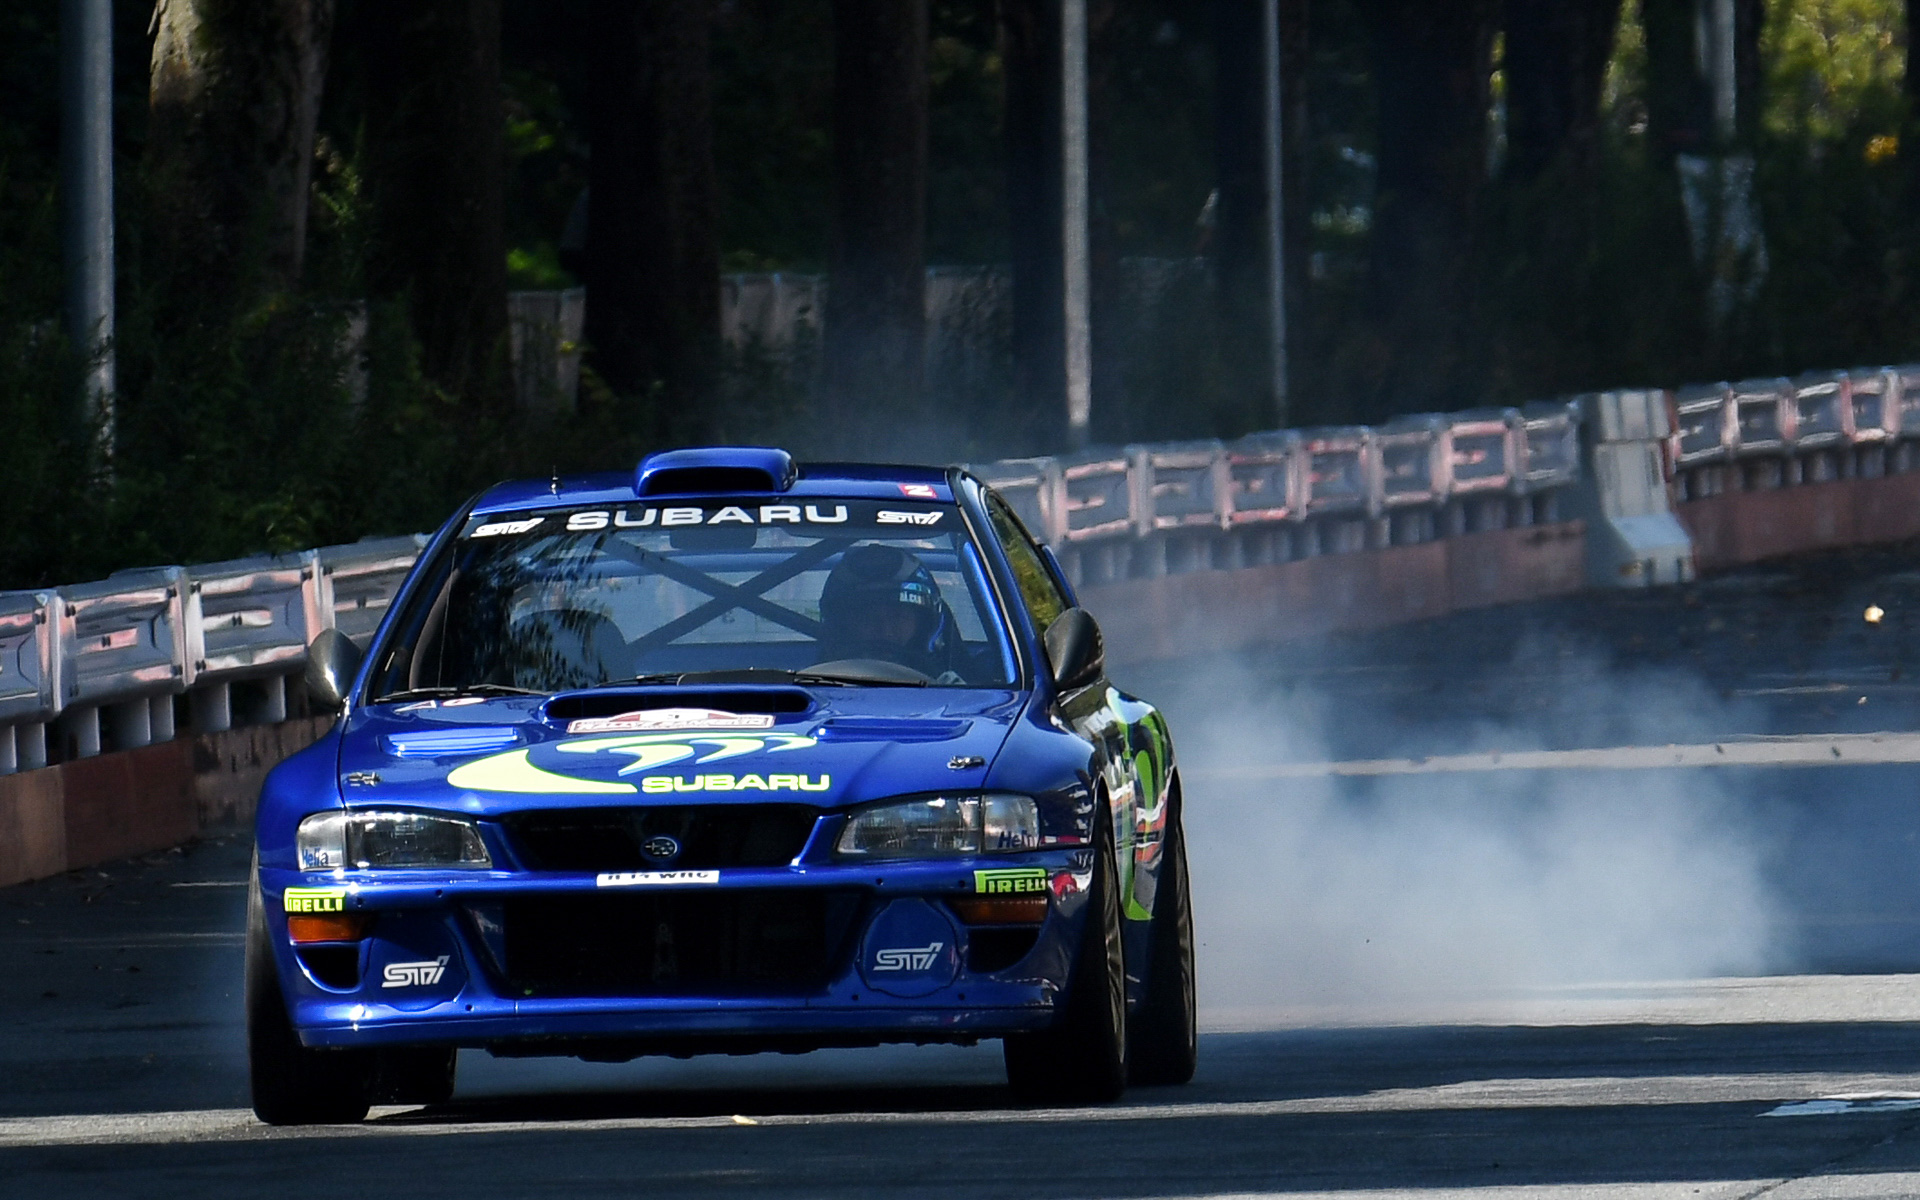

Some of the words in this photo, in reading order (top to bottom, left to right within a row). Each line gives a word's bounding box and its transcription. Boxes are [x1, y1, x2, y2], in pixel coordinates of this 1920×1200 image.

[566, 504, 848, 531] SUBARU
[642, 774, 830, 793] SUBARU
[974, 868, 1047, 893] PIRELLI
[284, 887, 346, 912] PIRELLI
